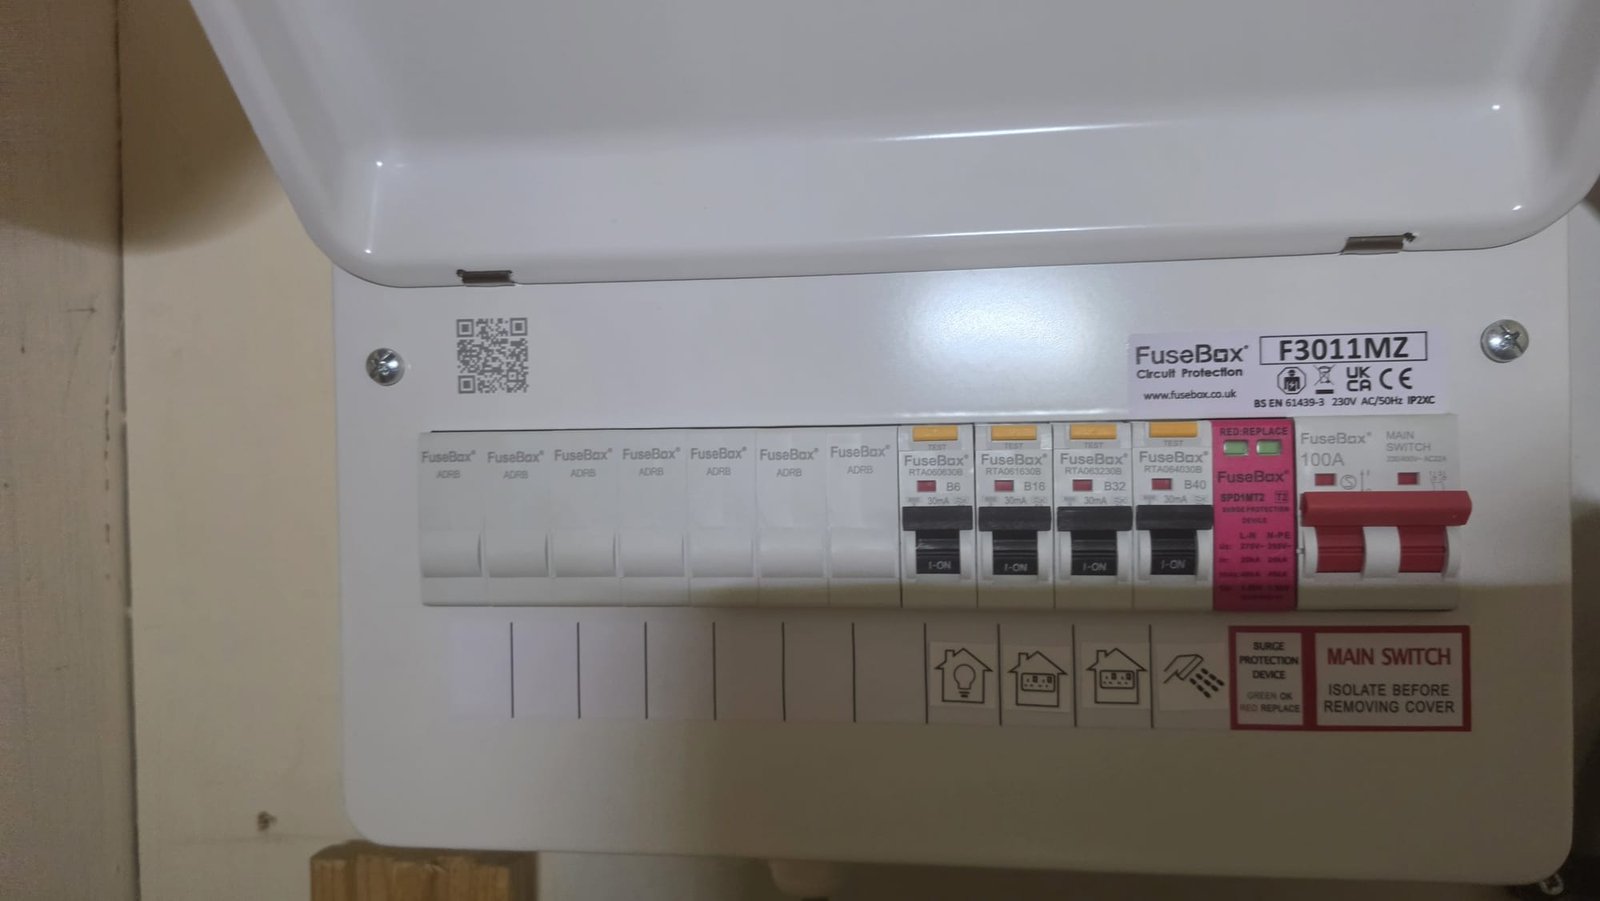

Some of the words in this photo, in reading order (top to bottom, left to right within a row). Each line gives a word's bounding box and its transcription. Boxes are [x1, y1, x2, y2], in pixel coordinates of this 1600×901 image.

[1279, 336, 1409, 361] F3011MZ
[1135, 344, 1244, 365] FuseBox
[1136, 368, 1176, 379] Circuit
[1181, 367, 1243, 378] Protection
[1346, 366, 1371, 379] UK
[1379, 367, 1413, 390] CE
[1346, 380, 1372, 392] CA
[1143, 389, 1237, 400] www.fusebox.co.uk
[1254, 399, 1267, 408] BS
[1269, 399, 1283, 408] EN
[1285, 398, 1325, 407] 61439-3
[1332, 397, 1357, 406] 230V
[1361, 396, 1403, 406] AC/50Hz
[1407, 395, 1436, 405] IP2XC
[1300, 432, 1366, 445] FuseBox
[1386, 431, 1415, 440] MAIN
[1386, 442, 1431, 452] SWITCH
[1301, 452, 1345, 467] 100A
[436, 470, 461, 479] ADRB
[503, 470, 529, 479] ADRB
[570, 468, 597, 478] ADRB
[638, 467, 664, 477] ADRB
[706, 467, 731, 476] ADRB
[776, 467, 802, 477] ADRB
[847, 465, 873, 475] ADRB
[946, 482, 961, 492] B6
[1023, 481, 1046, 491] B16
[1104, 481, 1126, 491] B32
[1184, 479, 1207, 490] B40
[927, 496, 950, 505] 30mA
[1004, 496, 1027, 505] 30mA
[1083, 496, 1107, 505] 30mA
[1163, 495, 1188, 504] 30mA
[1221, 492, 1265, 502] SPD1MT2
[1253, 641, 1285, 651] SURGE
[1239, 655, 1299, 665] PROTECTION
[1327, 648, 1375, 666] MAIN
[1382, 648, 1451, 666] SWITCH
[1252, 670, 1287, 680] DEVICE
[1328, 683, 1387, 696] ISOLATE
[1392, 683, 1450, 696] BEFORE
[1247, 691, 1277, 700] GREEN
[1279, 692, 1293, 700] OK
[1239, 704, 1258, 712] RED
[1260, 704, 1301, 713] REPLACE
[1324, 700, 1399, 713] REMOVING
[1405, 700, 1455, 713] COVER
